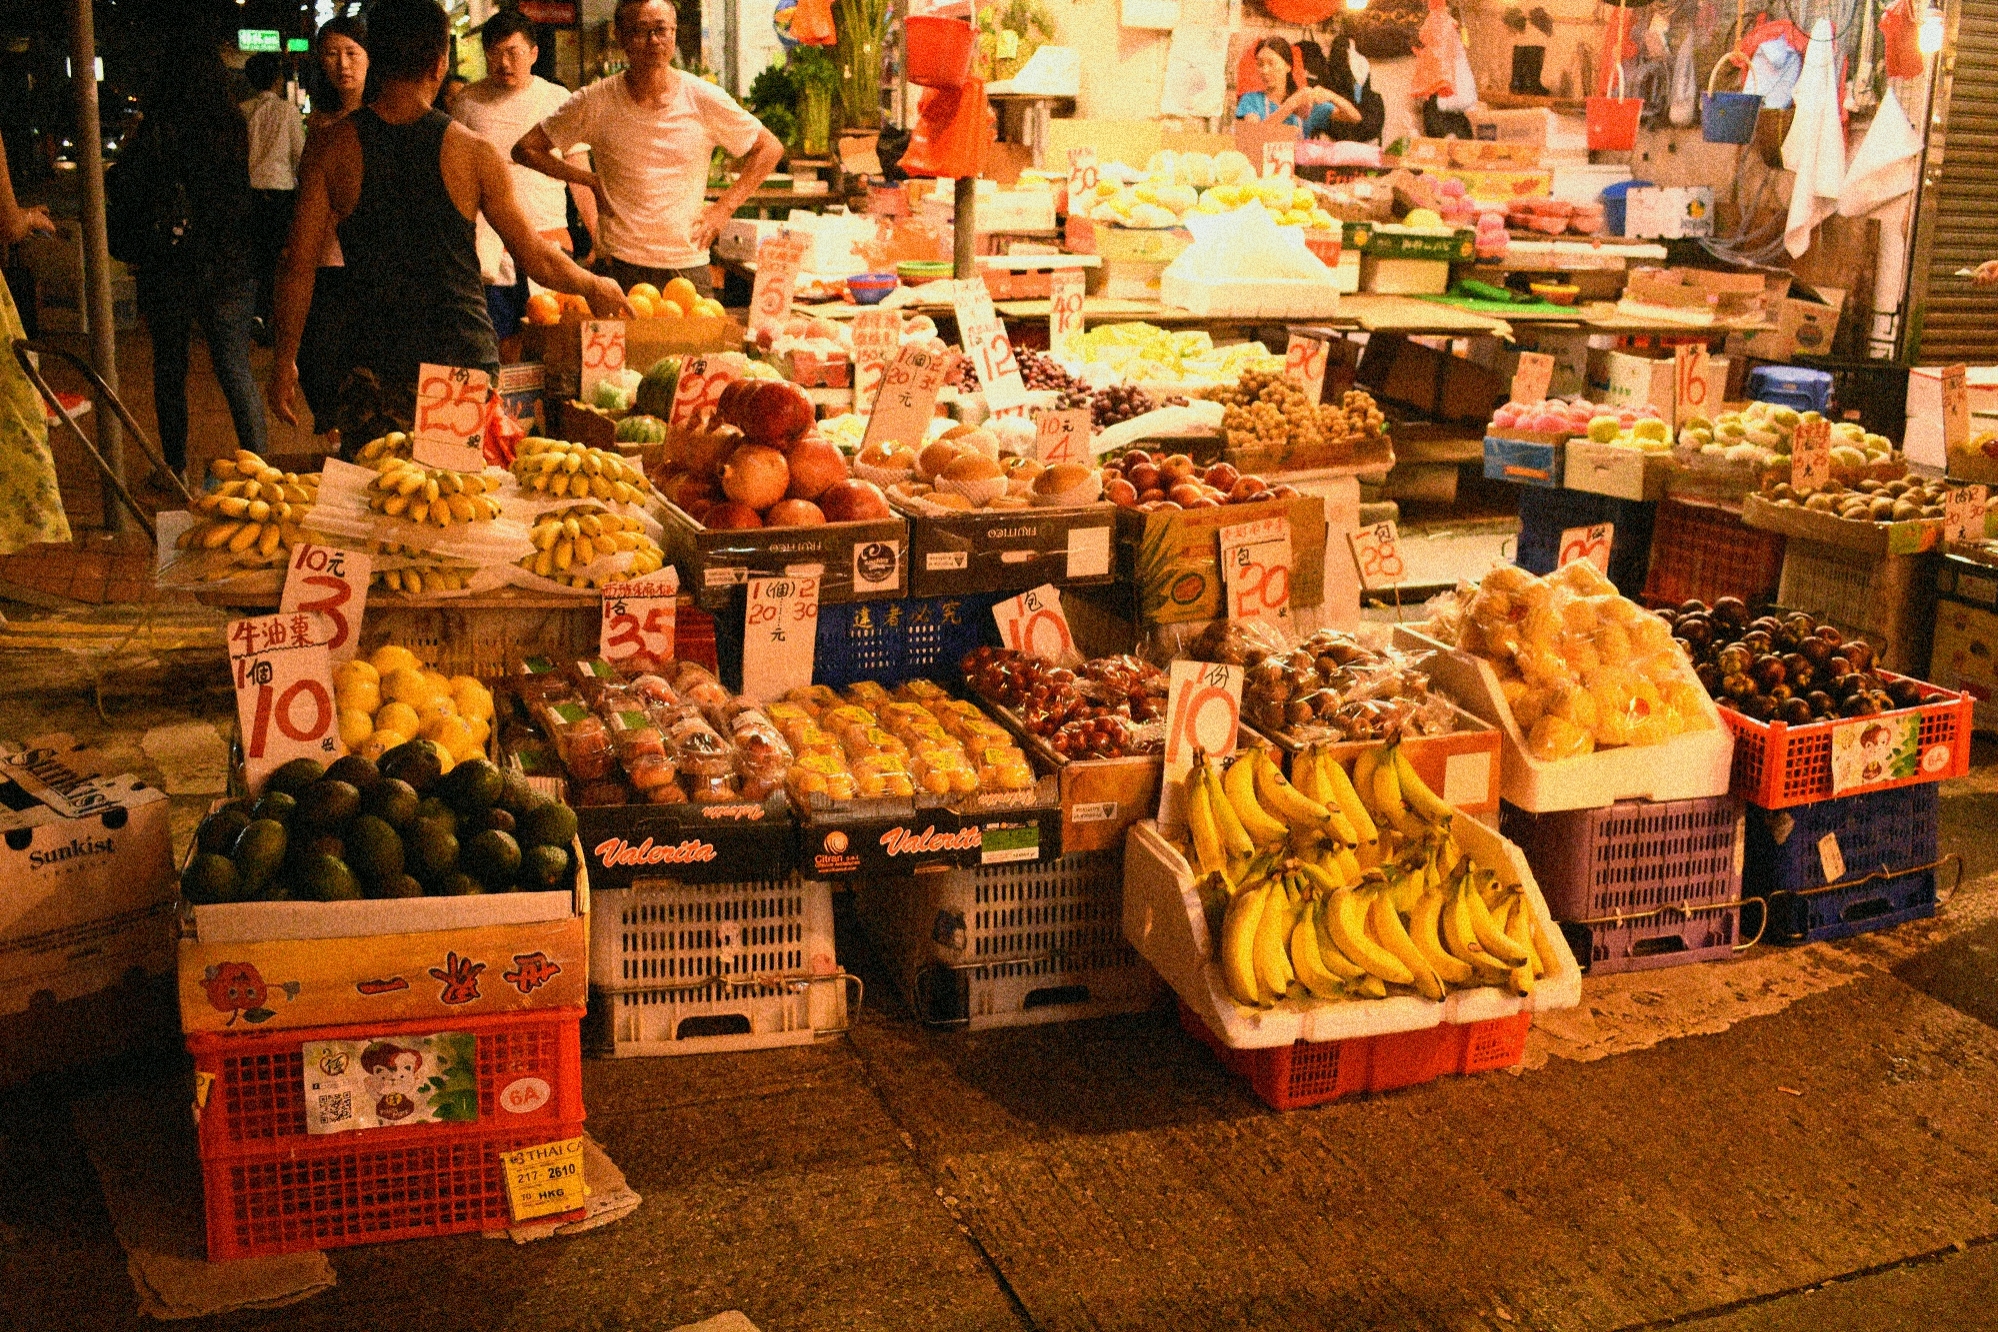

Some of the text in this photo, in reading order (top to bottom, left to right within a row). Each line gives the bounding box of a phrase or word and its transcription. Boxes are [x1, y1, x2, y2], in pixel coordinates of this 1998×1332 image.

[584, 332, 626, 369] 55
[982, 334, 1020, 382] 12
[887, 368, 910, 385] 20
[1679, 350, 1706, 405] 16
[420, 376, 487, 437] 25
[899, 392, 912, 408] 元
[1041, 418, 1074, 435] 10元
[1046, 434, 1075, 463] 4
[295, 543, 346, 577] 10元
[1361, 541, 1404, 577] 28
[753, 581, 760, 599] 1
[800, 579, 815, 598] 2
[1237, 562, 1290, 617] 20
[297, 575, 352, 649] 3
[749, 602, 818, 625] 20 30
[232, 615, 314, 655] 牛油菓
[607, 607, 675, 664] 35
[770, 627, 786, 643] 元
[1009, 609, 1070, 660] 10
[249, 679, 333, 759] 10
[1166, 678, 1239, 765] 10
[29, 837, 115, 871] Sunkist
[594, 836, 718, 869] Valerita
[509, 1085, 540, 1107] 6A
[527, 1145, 563, 1162] THAI
[548, 1163, 575, 1179] 2610
[538, 1188, 564, 1200] HKG
